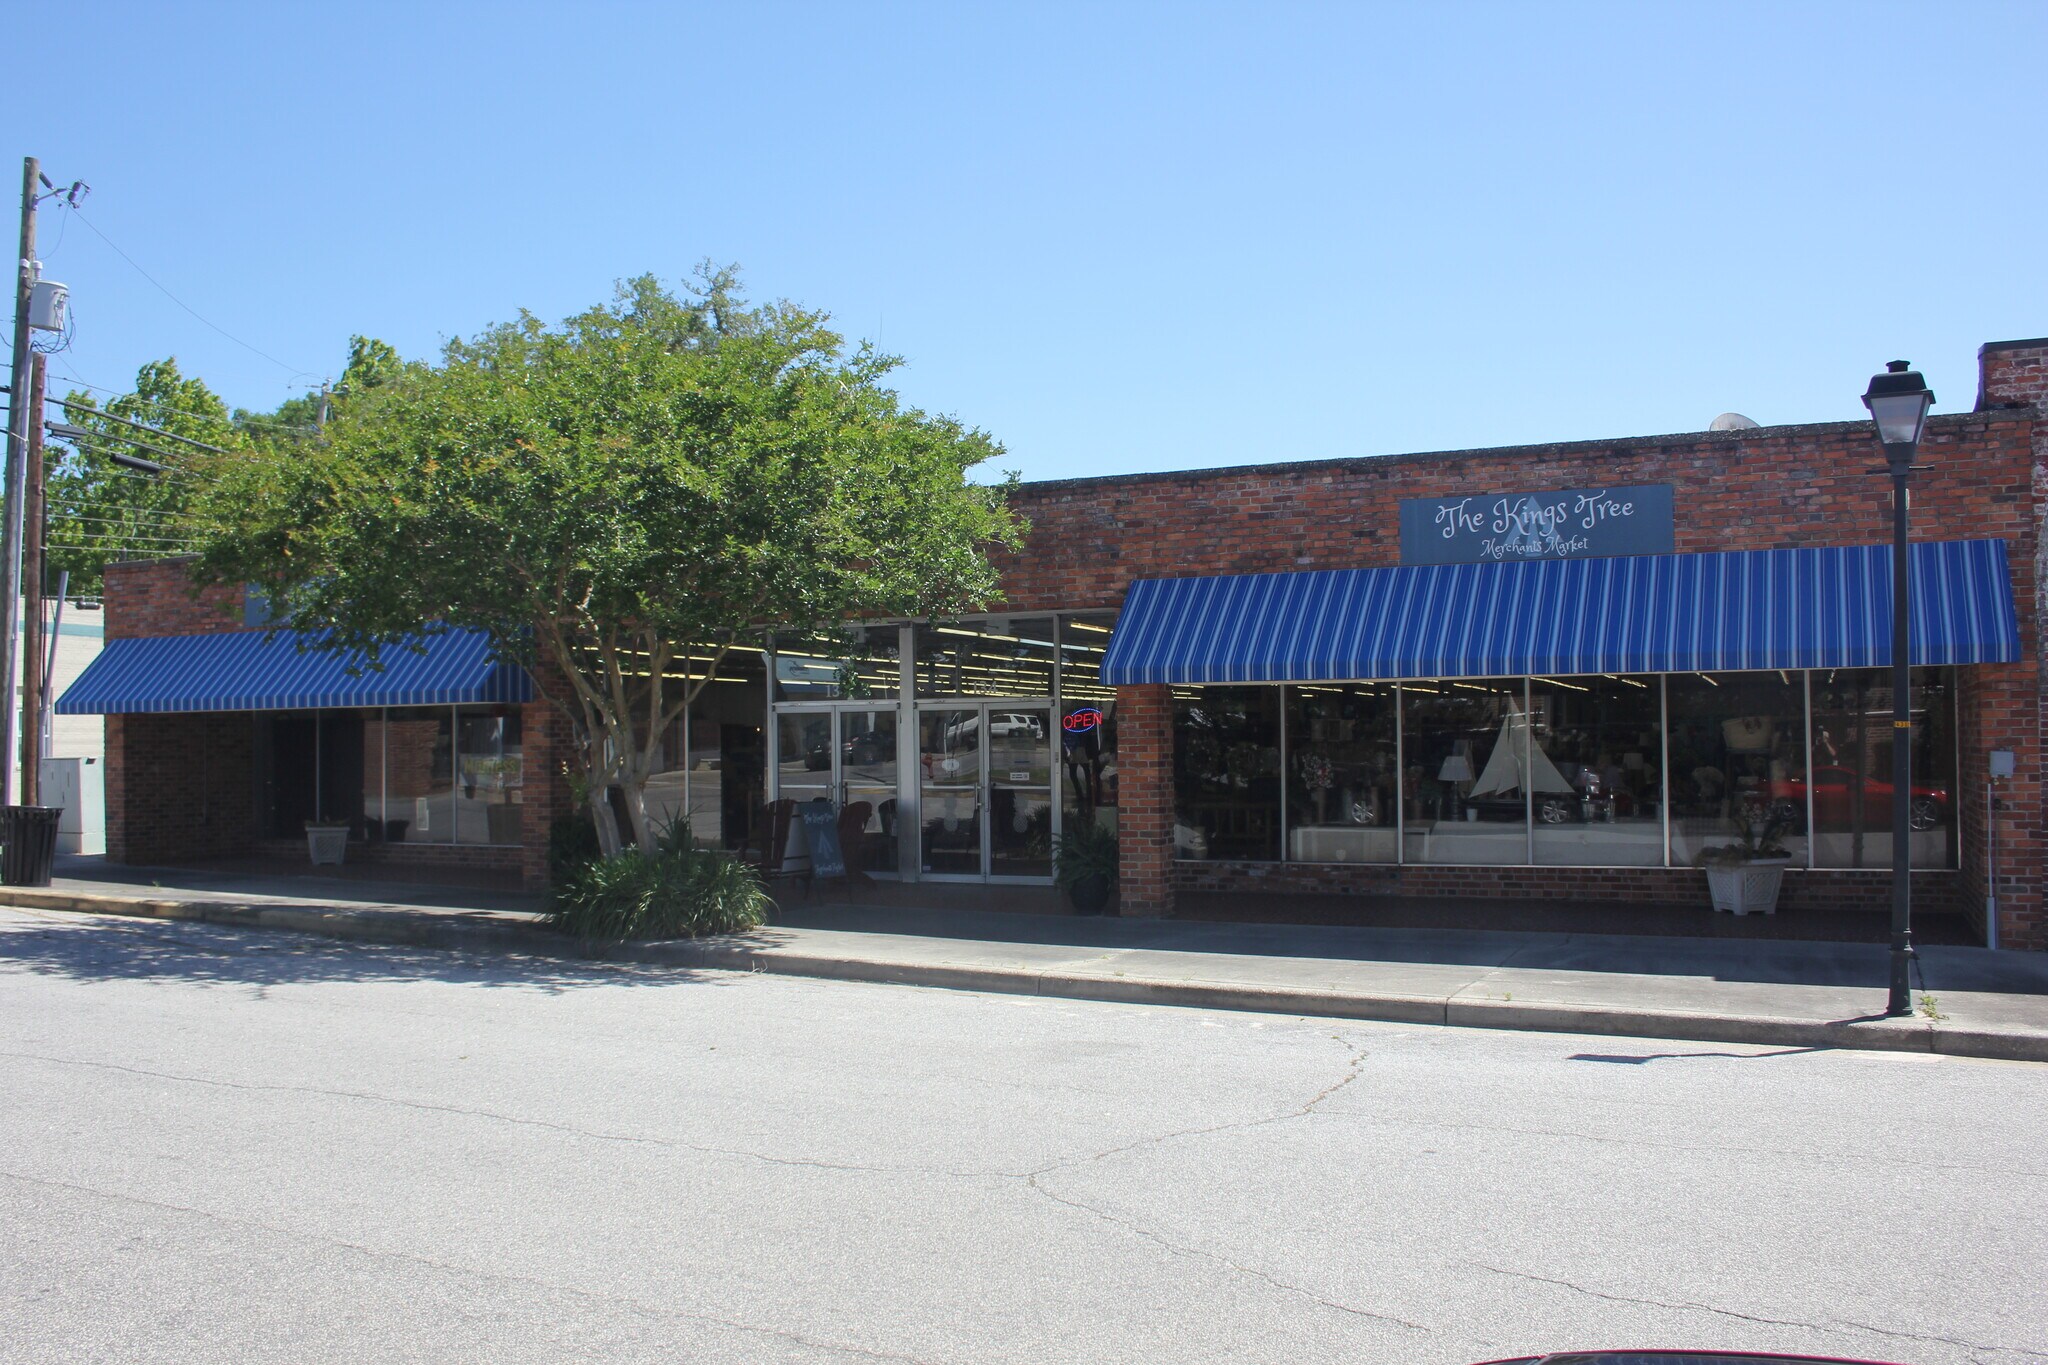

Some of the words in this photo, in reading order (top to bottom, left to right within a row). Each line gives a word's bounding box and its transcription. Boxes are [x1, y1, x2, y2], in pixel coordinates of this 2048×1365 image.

[1435, 497, 1484, 538] The
[1492, 497, 1567, 537] Kings
[1574, 490, 1634, 529] Tree
[1480, 536, 1542, 559] Merchants
[1544, 534, 1588, 557] Market
[1063, 712, 1103, 729] OPEN
